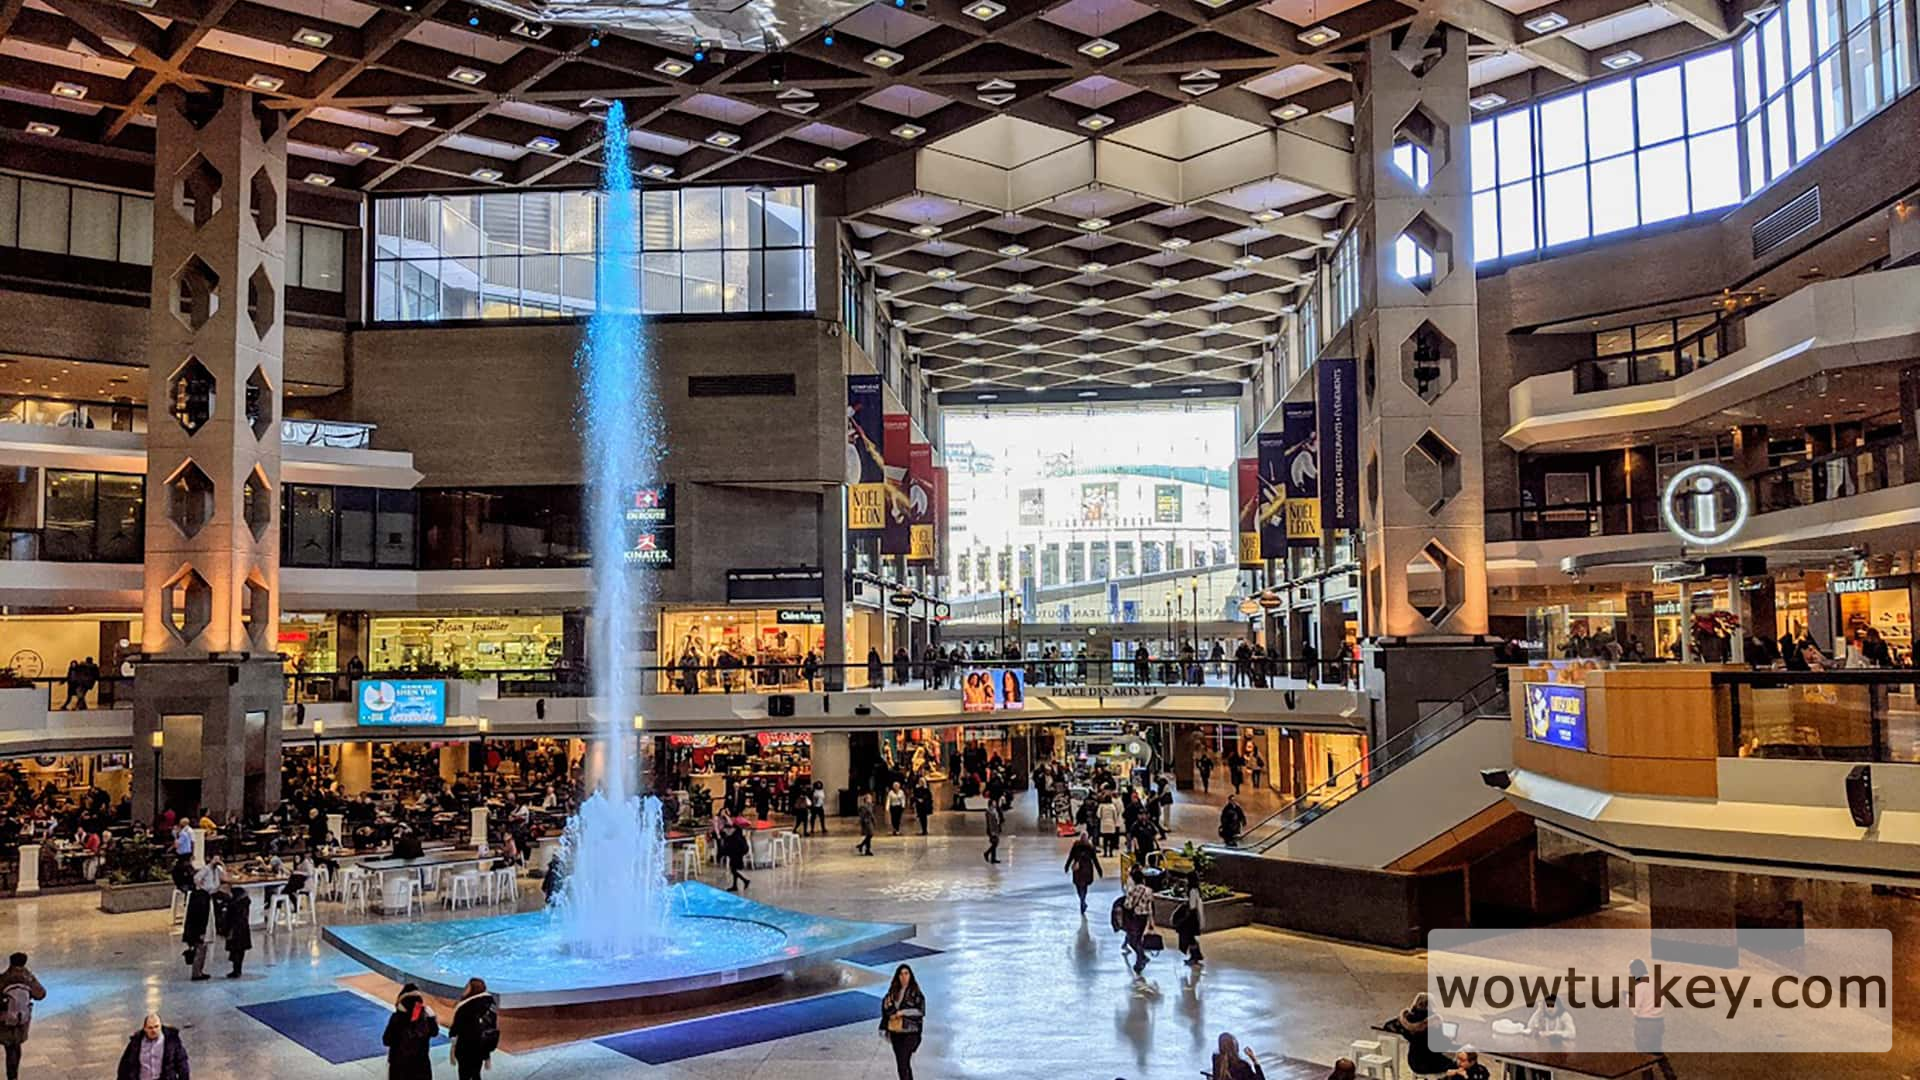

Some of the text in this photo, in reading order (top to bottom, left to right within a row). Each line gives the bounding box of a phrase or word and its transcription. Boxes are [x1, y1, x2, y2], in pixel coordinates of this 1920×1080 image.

[623, 550, 668, 559] KINATEX
[1052, 687, 1086, 697] PLACE
[1112, 687, 1140, 697] ARTS
